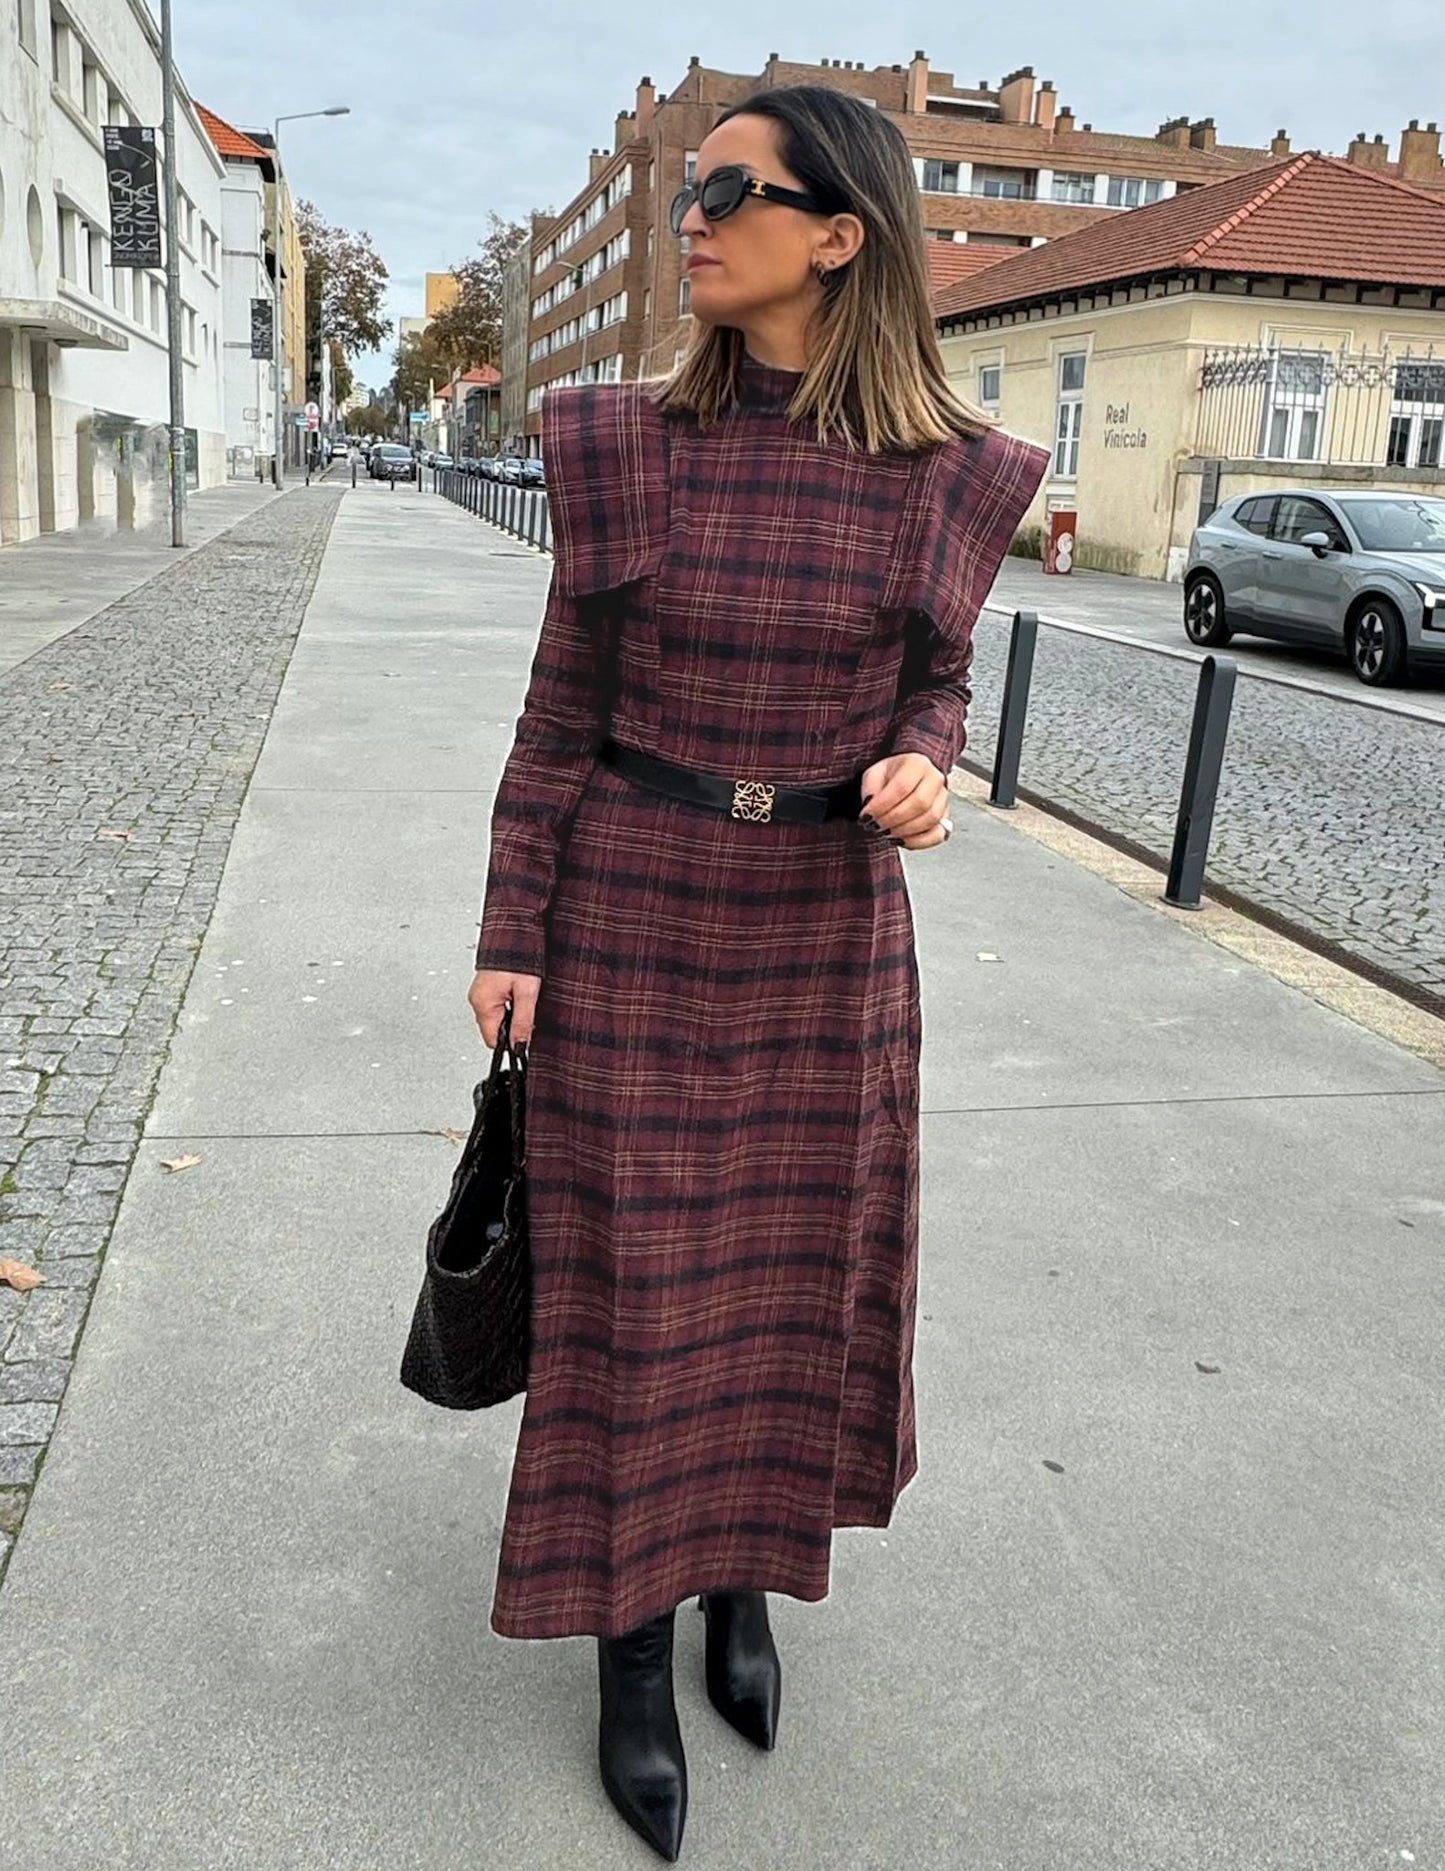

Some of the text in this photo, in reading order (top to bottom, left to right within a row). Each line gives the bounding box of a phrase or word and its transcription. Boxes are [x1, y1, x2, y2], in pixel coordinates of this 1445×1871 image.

[109, 169, 134, 251] KENGO
[135, 183, 159, 252] KUMA
[1105, 402, 1129, 424] Real
